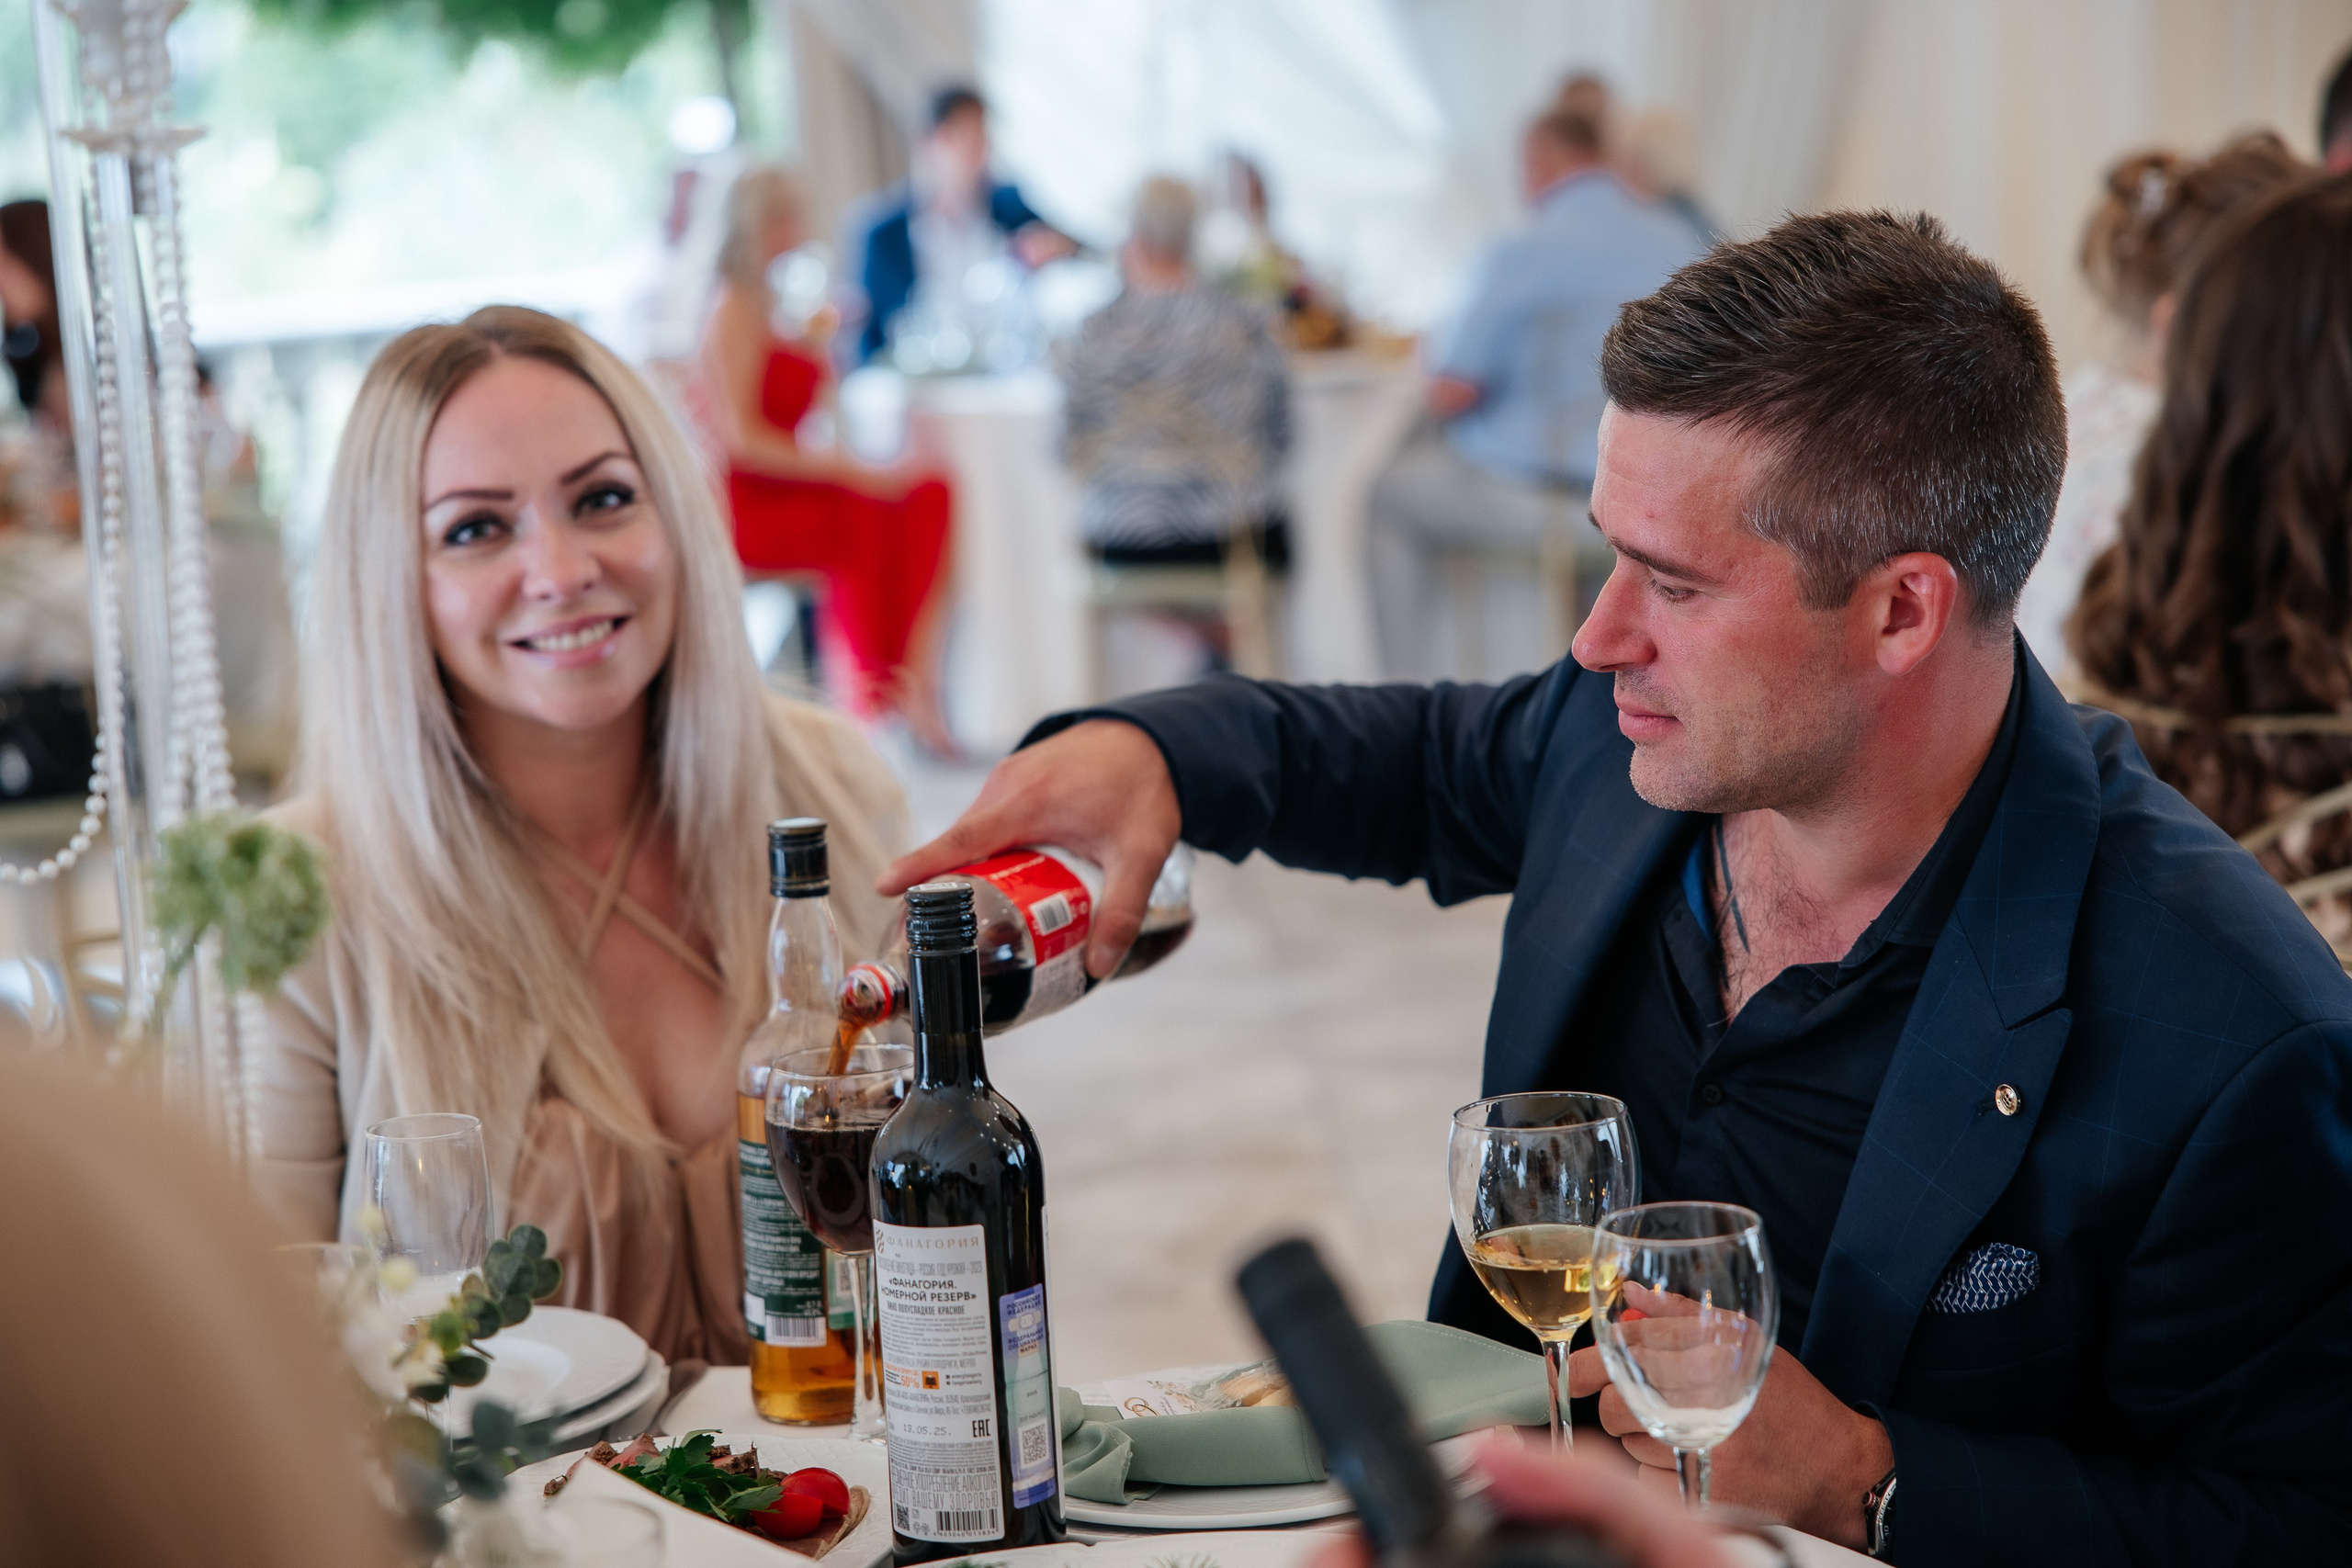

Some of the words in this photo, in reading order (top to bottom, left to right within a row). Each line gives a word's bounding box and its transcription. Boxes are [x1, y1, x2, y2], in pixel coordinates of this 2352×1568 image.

[887, 1236, 979, 1249] ФАНАГОРИЯ
[881, 1288, 927, 1302] НОМЕРНОЙ
[931, 1292, 977, 1302] РЕЗЕРВ»
[1006, 1293, 1041, 1310] РОССИЙСКАЯ
[899, 1303, 935, 1316] ПОЛУСЛАДКОЕ
[938, 1304, 966, 1315] КРАСНОЕ
[1007, 1300, 1041, 1315] ФЕДЕРАЦИЯ
[1008, 1327, 1044, 1344] ФЕДЕРАЛЬНАЯ
[900, 1375, 920, 1388] 50%
[903, 1424, 952, 1436] 13.05.25.
[972, 1418, 991, 1438] EAC
[915, 1470, 961, 1493] УПОТРЕБЛЕНИЕ
[962, 1472, 998, 1492] АЛКОГОЛЯ
[912, 1488, 944, 1509] ВАШЕМУ
[949, 1490, 999, 1511] ЗДОРОВЬЮ
